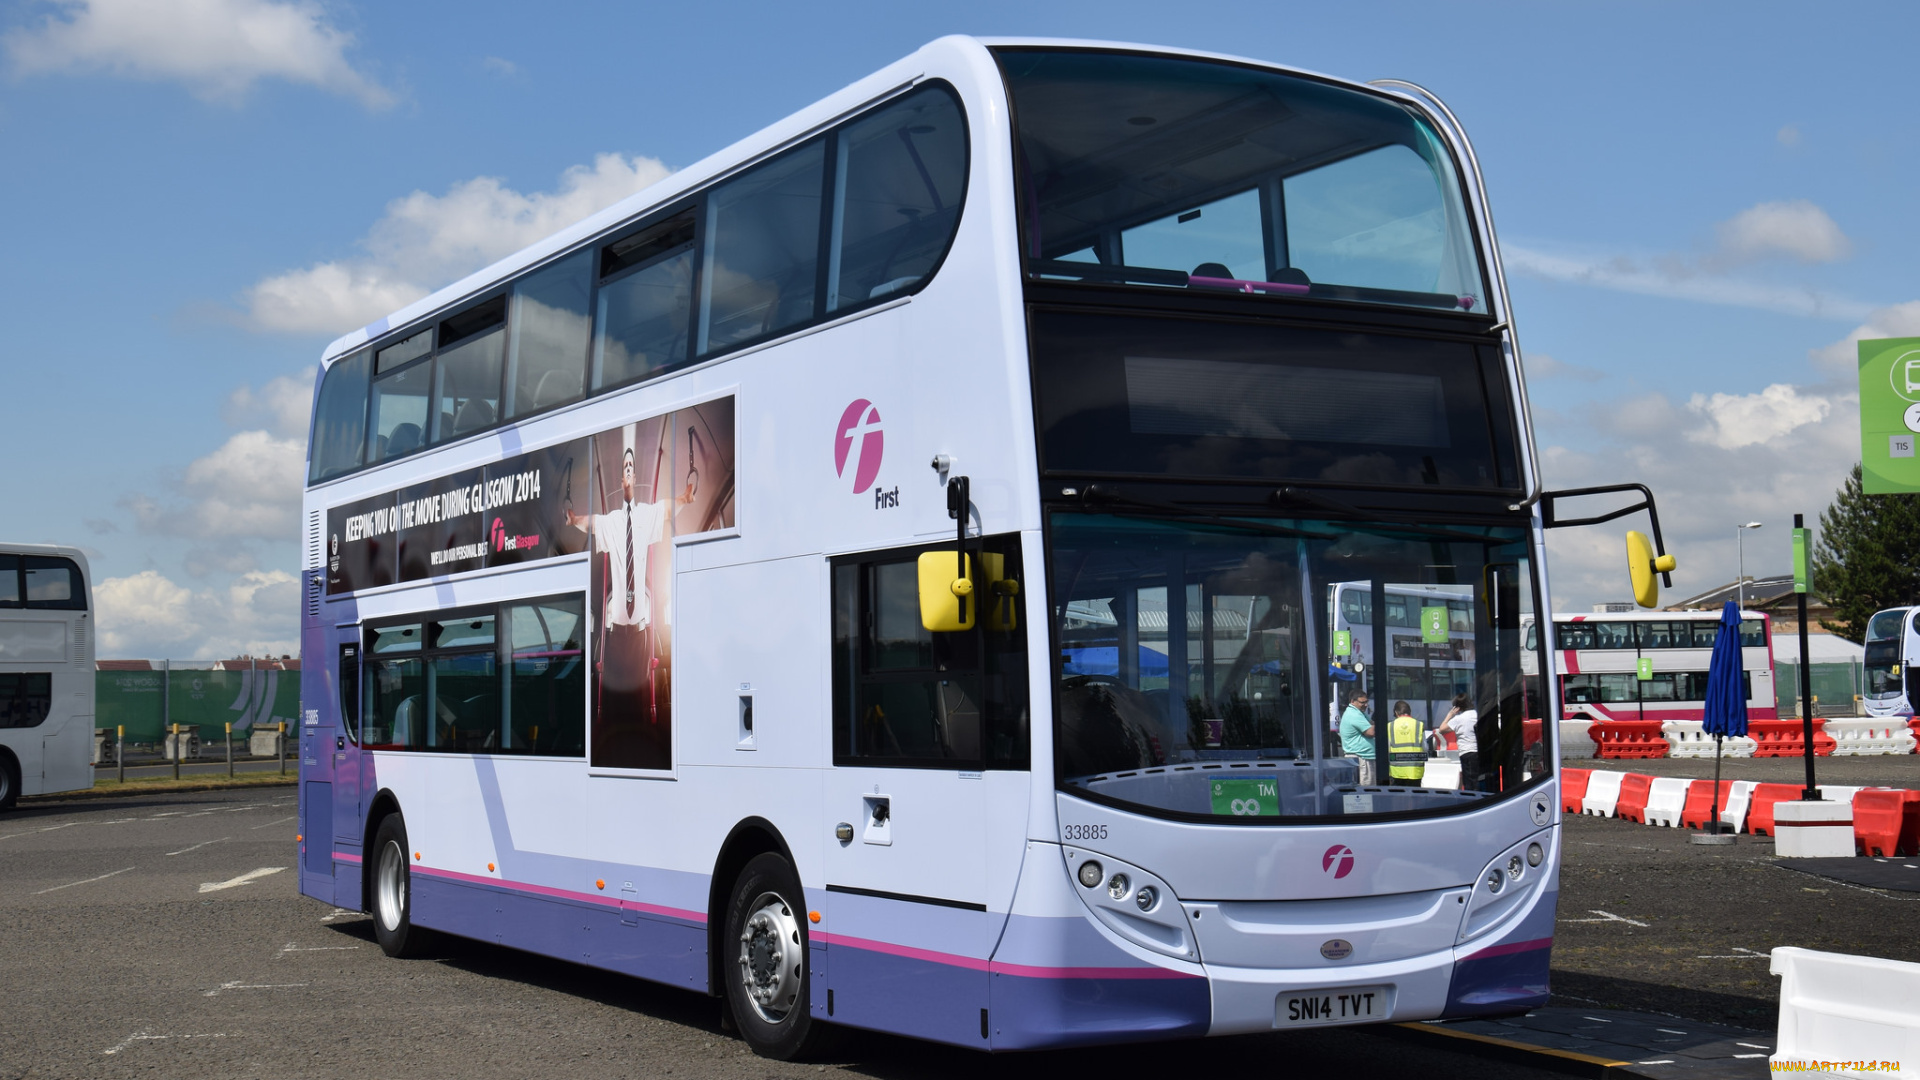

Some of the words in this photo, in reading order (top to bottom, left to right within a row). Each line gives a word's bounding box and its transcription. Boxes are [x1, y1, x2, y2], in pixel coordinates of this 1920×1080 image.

[1895, 442, 1909, 451] TIS
[875, 485, 899, 510] First
[345, 511, 374, 543] KEEPING
[374, 507, 388, 536] YOU
[389, 505, 402, 533] ON
[401, 500, 415, 530] THE
[415, 494, 440, 527] MOVE
[441, 485, 470, 521] DURING
[471, 474, 515, 514] GLASGOW
[515, 469, 540, 503] 2014
[305, 709, 319, 725] 33885
[1257, 783, 1276, 797] TM
[1064, 824, 1108, 840] 33885
[1288, 996, 1332, 1021] SN14
[1338, 993, 1374, 1017] TVT
